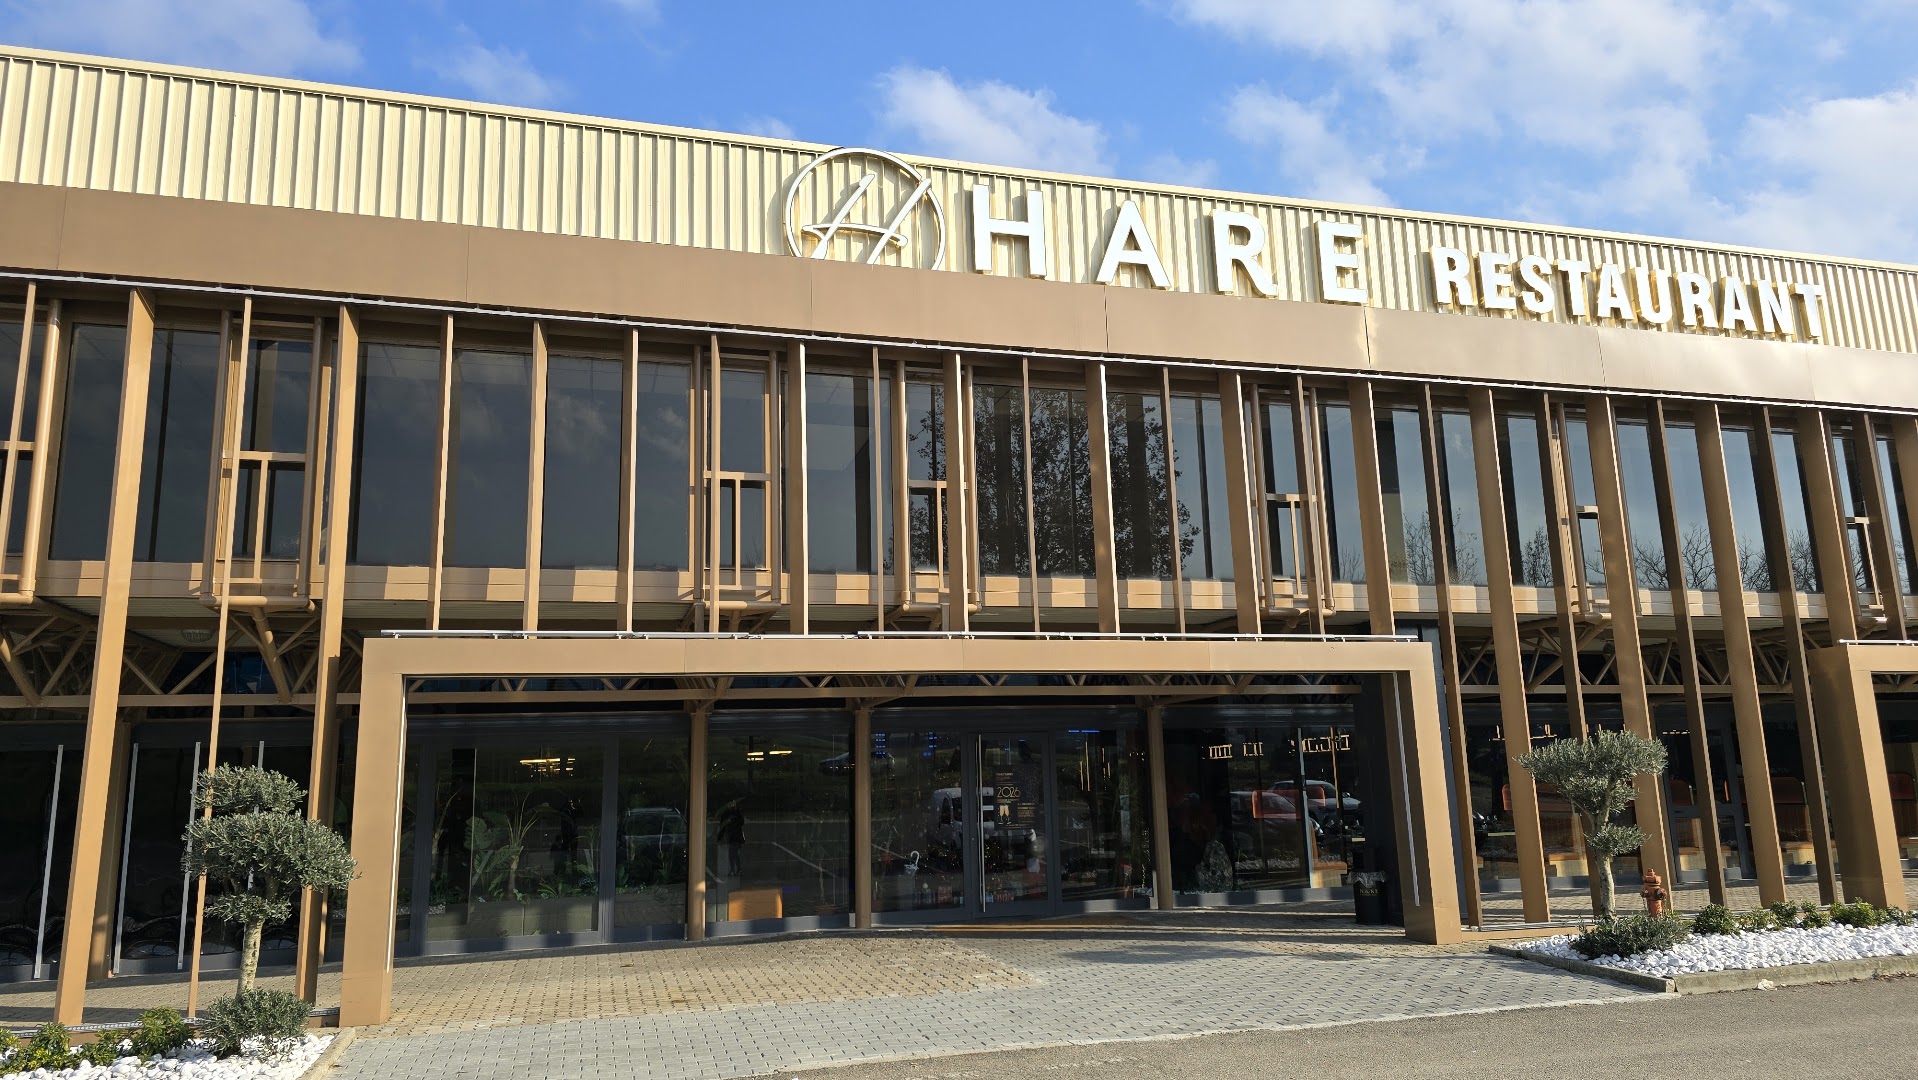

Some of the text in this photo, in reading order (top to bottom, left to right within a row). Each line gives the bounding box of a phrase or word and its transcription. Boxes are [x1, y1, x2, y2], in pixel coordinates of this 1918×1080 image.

[972, 184, 1822, 338] HARE RESTAURANT
[996, 786, 1021, 798] 2026
